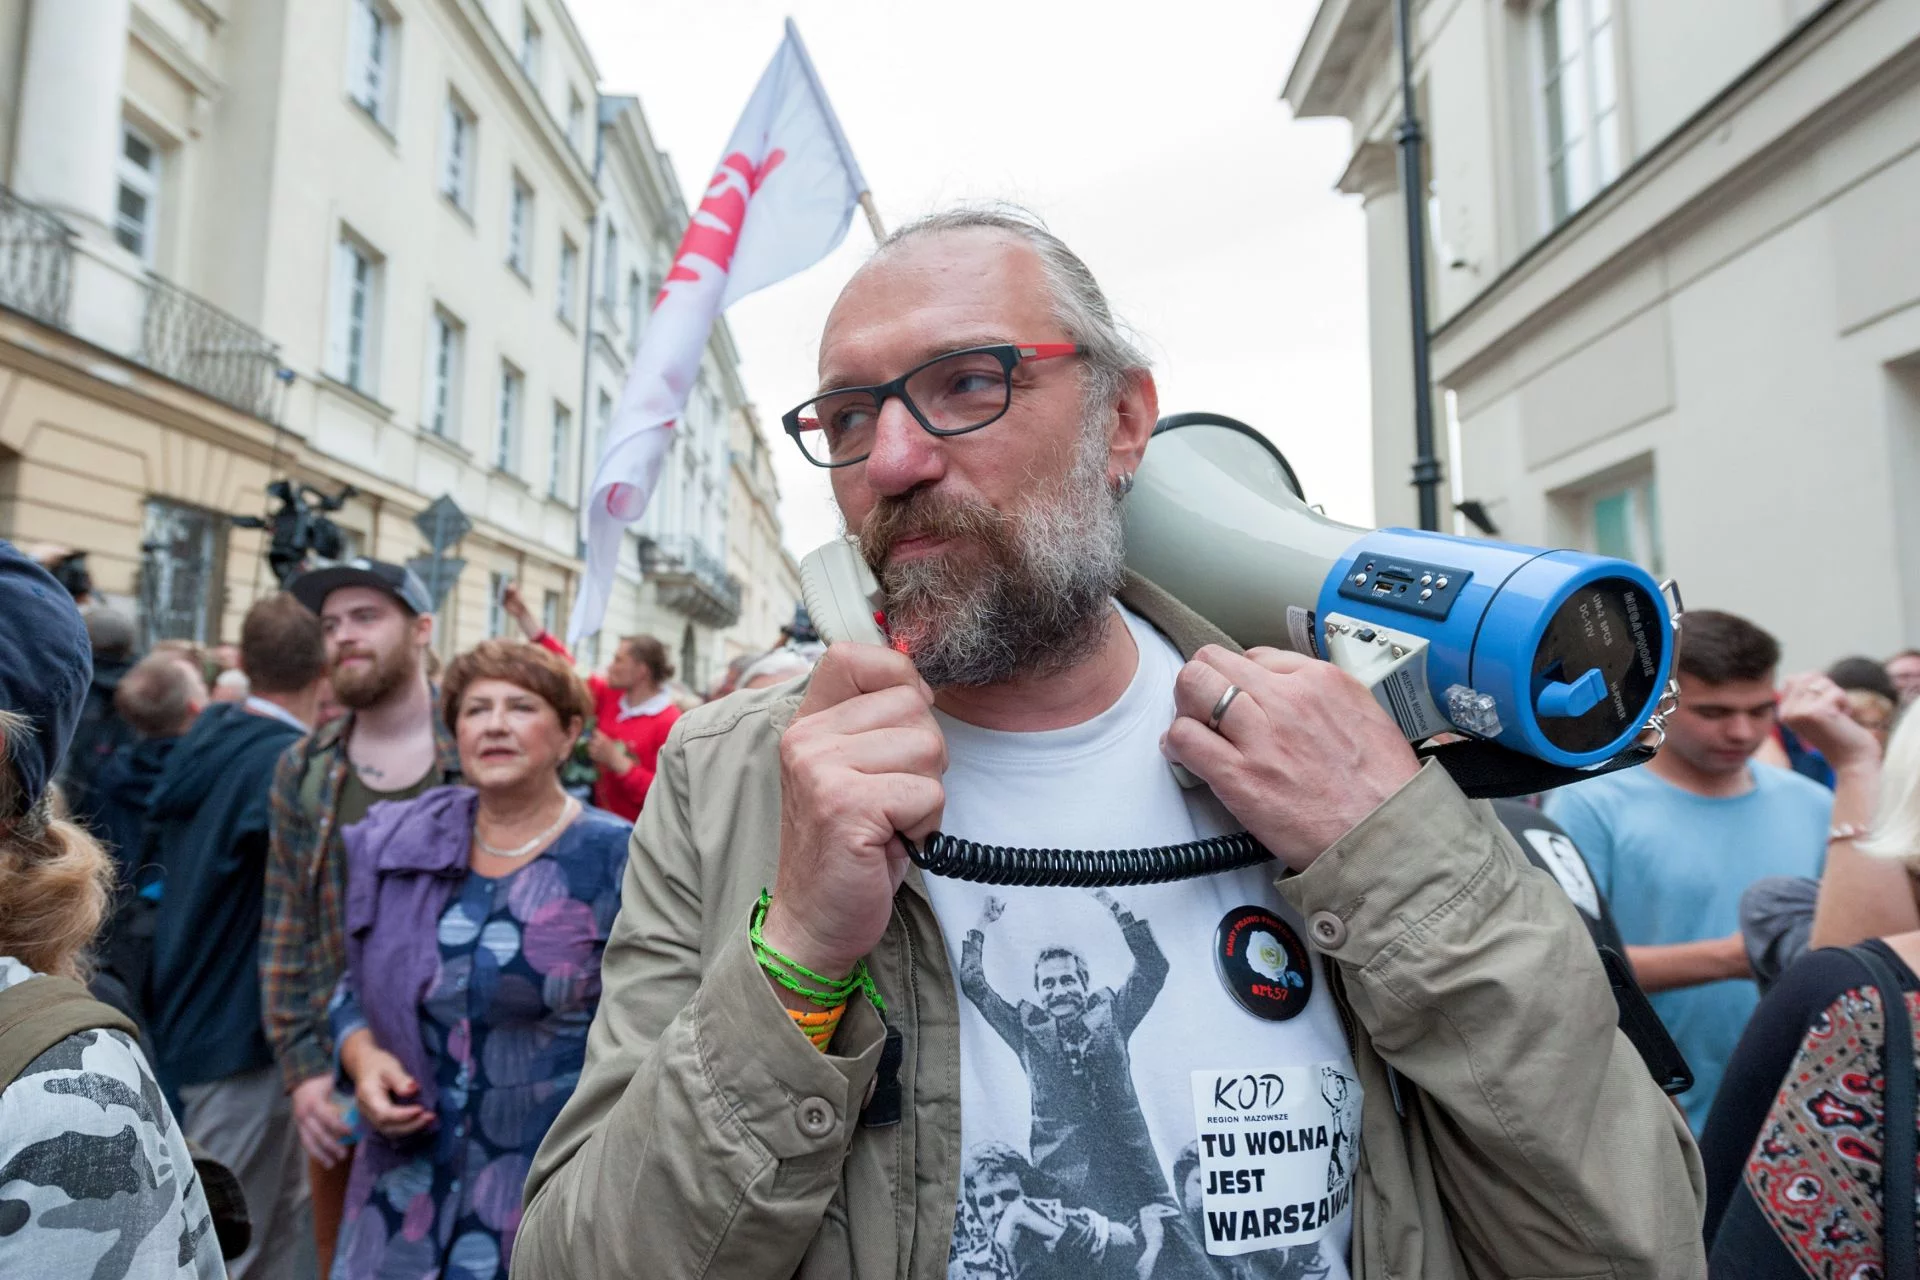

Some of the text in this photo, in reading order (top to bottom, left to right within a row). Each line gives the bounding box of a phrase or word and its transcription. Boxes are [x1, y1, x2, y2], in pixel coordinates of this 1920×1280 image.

[1579, 603, 1595, 638] DC-12V
[1593, 593, 1605, 619] UM-2
[1624, 591, 1655, 677] MEGAPHONE
[1214, 1074, 1284, 1111] KOD
[1207, 1113, 1289, 1124] REGION MAZOWSZE
[1201, 1125, 1329, 1158] TU WOLNA
[1206, 1168, 1265, 1195] JEST
[1208, 1183, 1350, 1242] WARSZAWA
